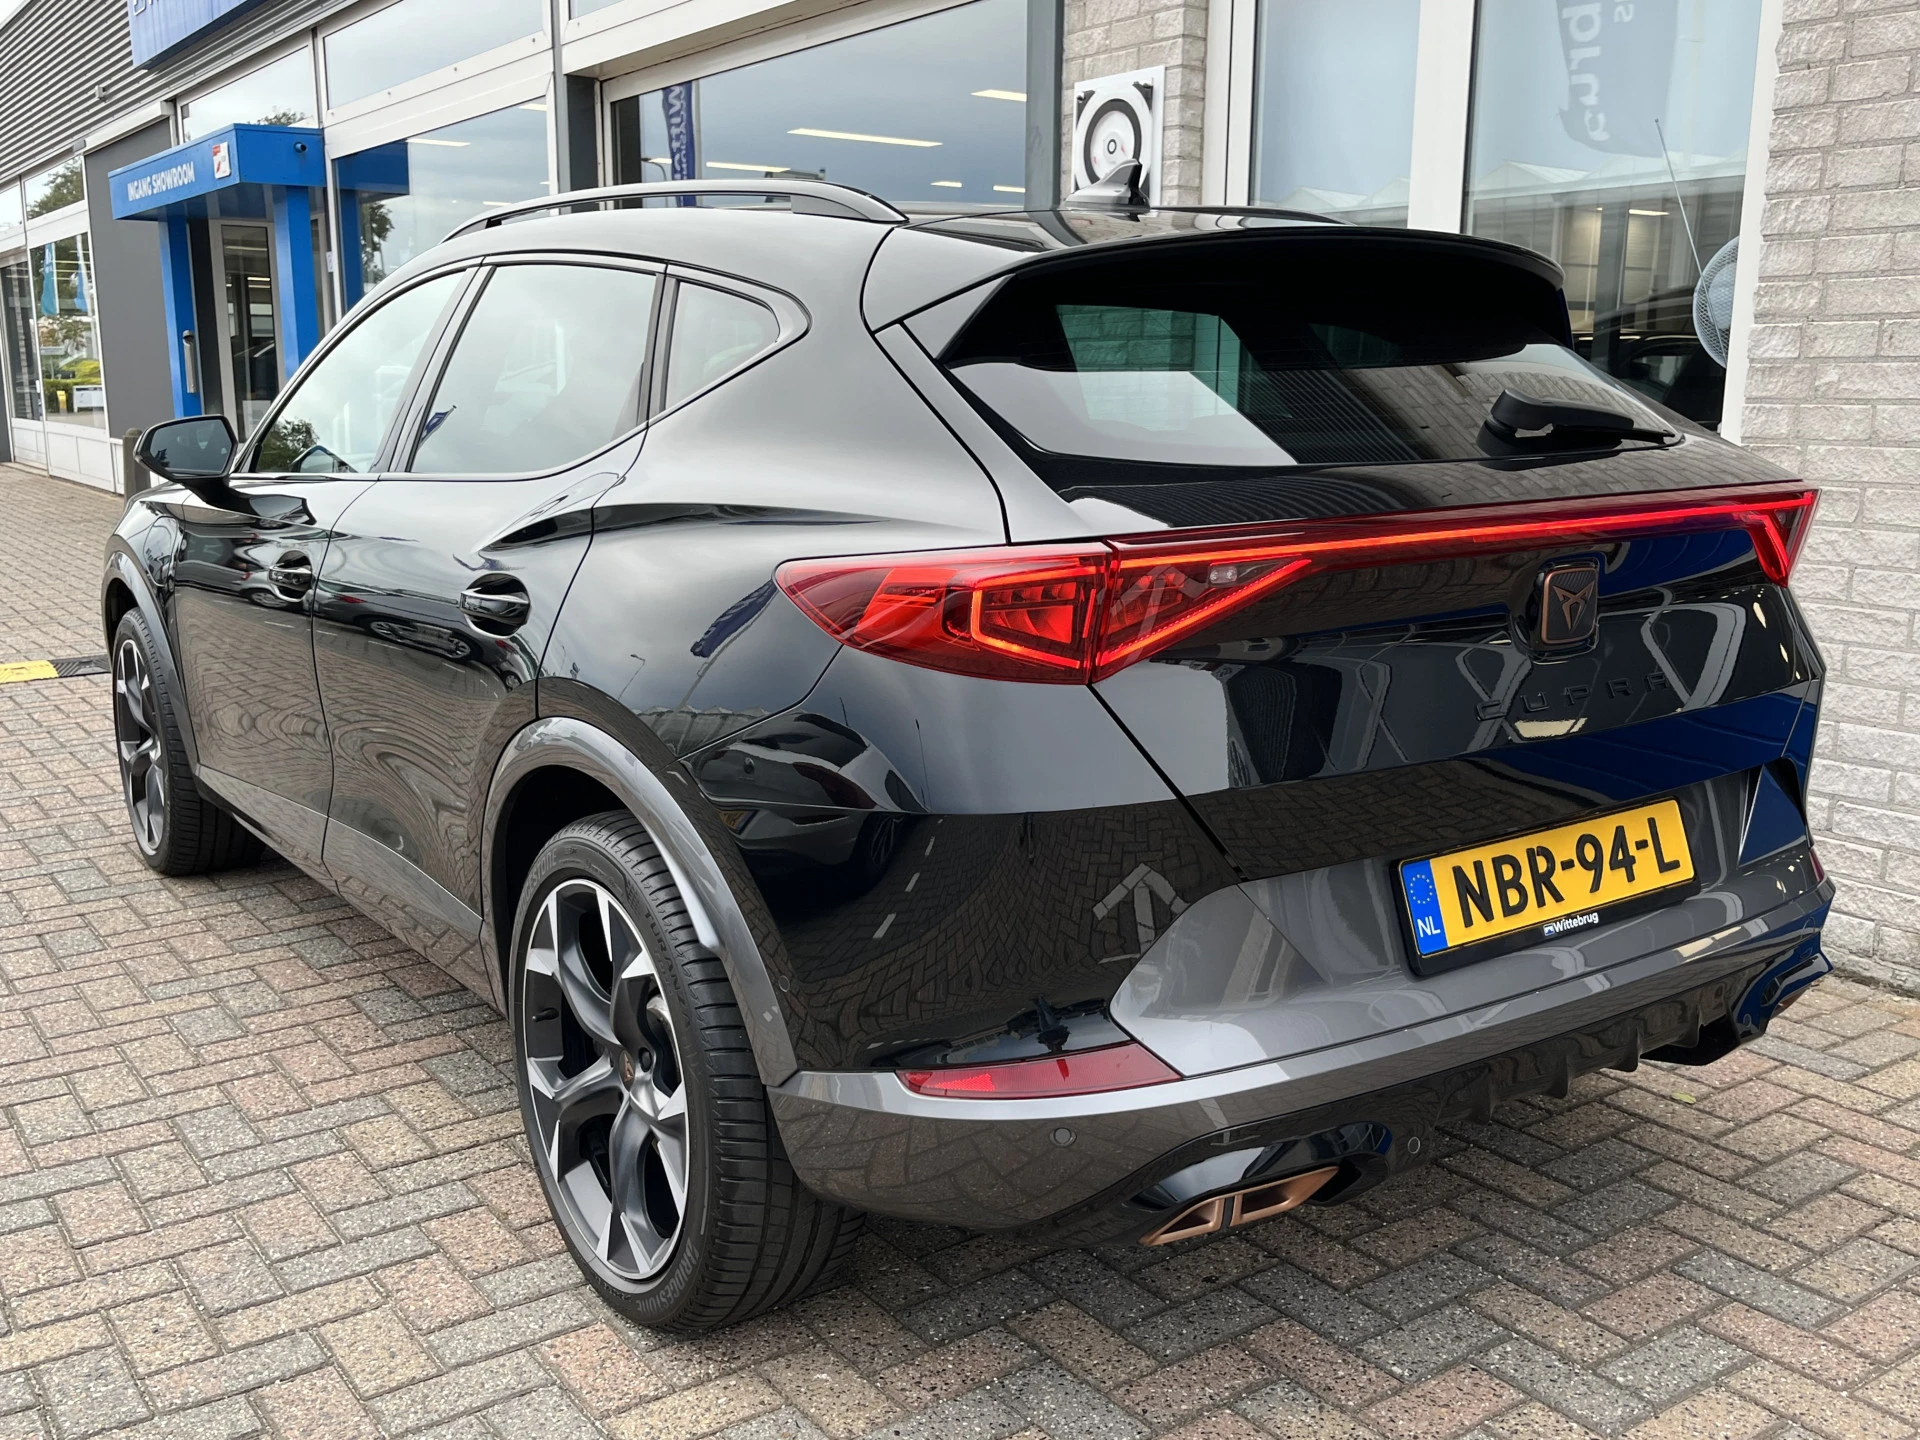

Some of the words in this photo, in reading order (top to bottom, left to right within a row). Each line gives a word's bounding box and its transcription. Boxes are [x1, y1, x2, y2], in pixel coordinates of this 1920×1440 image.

[127, 176, 152, 201] INGANG
[152, 161, 195, 194] SHOWROOM
[1475, 671, 1671, 721] CUPRA
[1453, 817, 1681, 928] NBR-94-L
[1417, 915, 1441, 938] NL
[1553, 912, 1599, 933] Wittebrug
